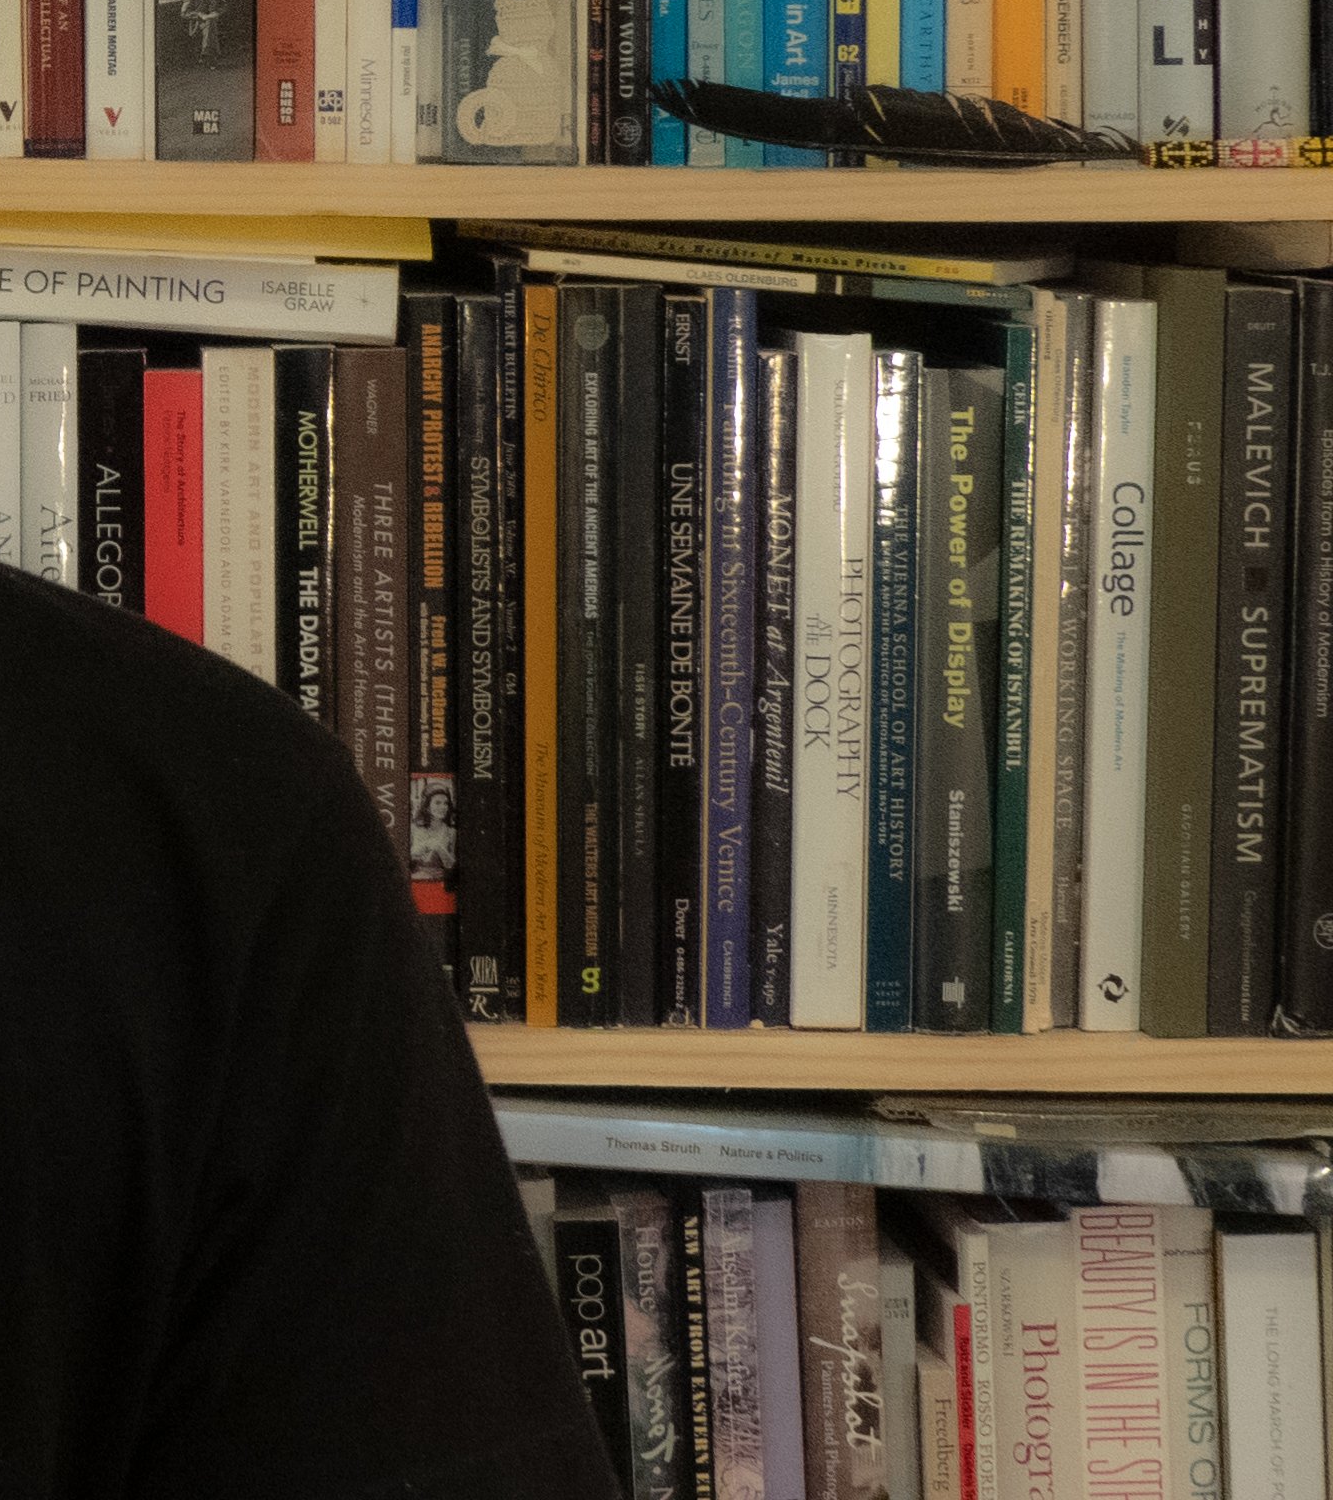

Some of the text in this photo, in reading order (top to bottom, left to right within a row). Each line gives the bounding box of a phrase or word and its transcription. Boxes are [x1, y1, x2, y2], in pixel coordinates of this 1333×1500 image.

[786, 4, 808, 24] in
[786, 29, 808, 65] Art
[24, 269, 67, 295] OF
[77, 271, 225, 304] PAINTING
[262, 281, 335, 298] ISABELLE
[284, 297, 333, 312] GRAW
[1103, 481, 1145, 617] Collage
[669, 462, 697, 767] UNE SEMAINE DE BONTÉ
[942, 407, 974, 913] The Power of Display Staniszewski
[1235, 362, 1275, 865] MALEVICH SUPREMATISM
[605, 1137, 656, 1152] Thomas
[661, 1140, 700, 1155] Struth
[720, 1145, 762, 1158] Nature
[777, 1151, 823, 1163] Politics
[569, 1255, 617, 1380] pop art
[808, 1273, 879, 1450] Snapshot
[1079, 1213, 1162, 1451] BEAUTY IS IN THE
